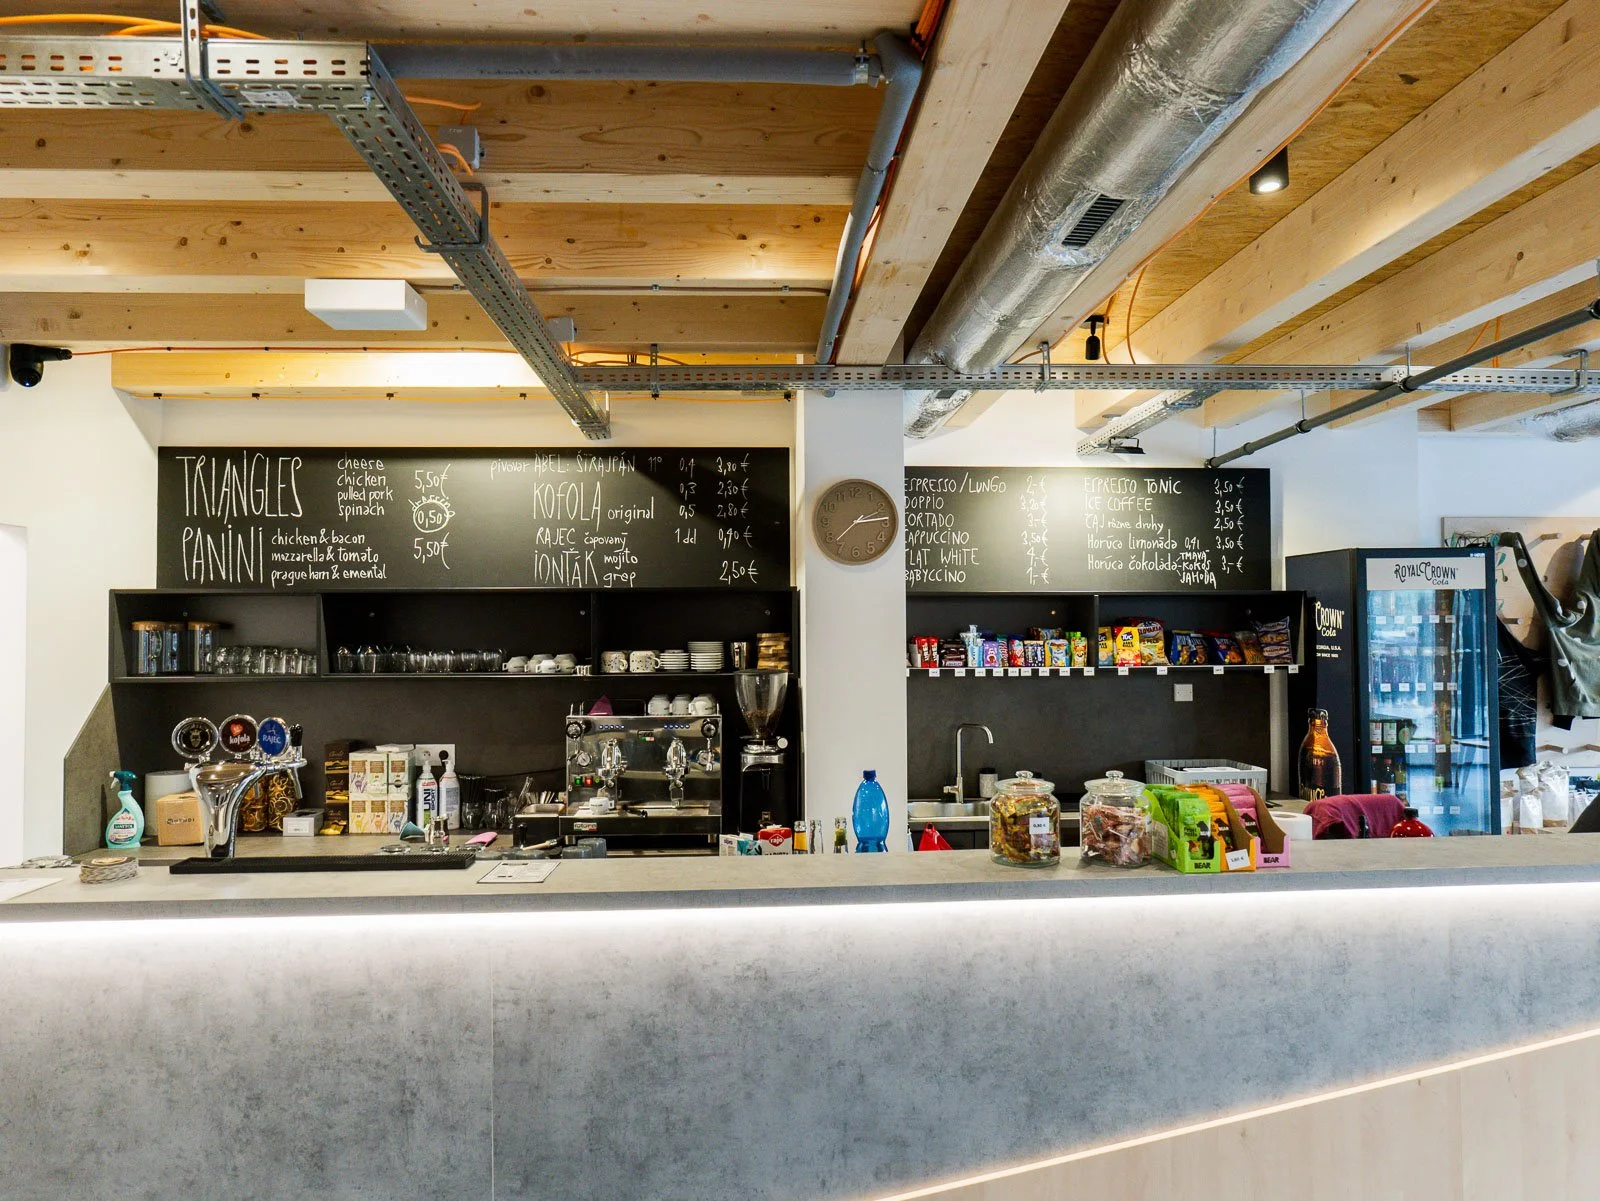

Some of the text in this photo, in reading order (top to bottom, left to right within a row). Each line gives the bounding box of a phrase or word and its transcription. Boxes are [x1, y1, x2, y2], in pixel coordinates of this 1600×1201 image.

[337, 453, 385, 471] cheese
[490, 460, 532, 480] pivovar
[176, 450, 303, 524] TRIANGLES
[337, 472, 387, 488] chicken
[1084, 477, 1138, 494] ESPRESSO
[1143, 476, 1182, 495] TONIC
[337, 484, 394, 502] pulled pork
[679, 482, 697, 501] 0,3
[338, 502, 386, 522] spinach
[533, 480, 654, 532] KOFOLA original
[679, 504, 696, 520] 0,5
[1107, 497, 1153, 511] COFFEE
[417, 510, 443, 529] 0,50
[1135, 514, 1164, 535] druhy
[271, 528, 366, 546] chicken & bacon
[536, 527, 576, 548] RAJEC
[1087, 532, 1123, 550] Horúca
[1128, 528, 1178, 550] limonáda
[271, 546, 379, 564] mozzarella & tomato
[604, 547, 639, 570] mojito
[940, 548, 980, 566] WHITE
[1087, 552, 1123, 571] Horúca
[1128, 551, 1178, 571] čokoláda
[271, 564, 388, 590] prague ham & emental
[602, 570, 636, 588] grep
[1180, 569, 1217, 590] JAHODA
[1394, 561, 1456, 583] ROYAL CROWN
[1432, 578, 1449, 586] Cola
[1315, 601, 1343, 630] CROWN
[1321, 627, 1336, 637] Cola
[229, 734, 251, 745] kofola
[262, 735, 282, 744] RAJEC
[1263, 856, 1280, 864] BEAR
